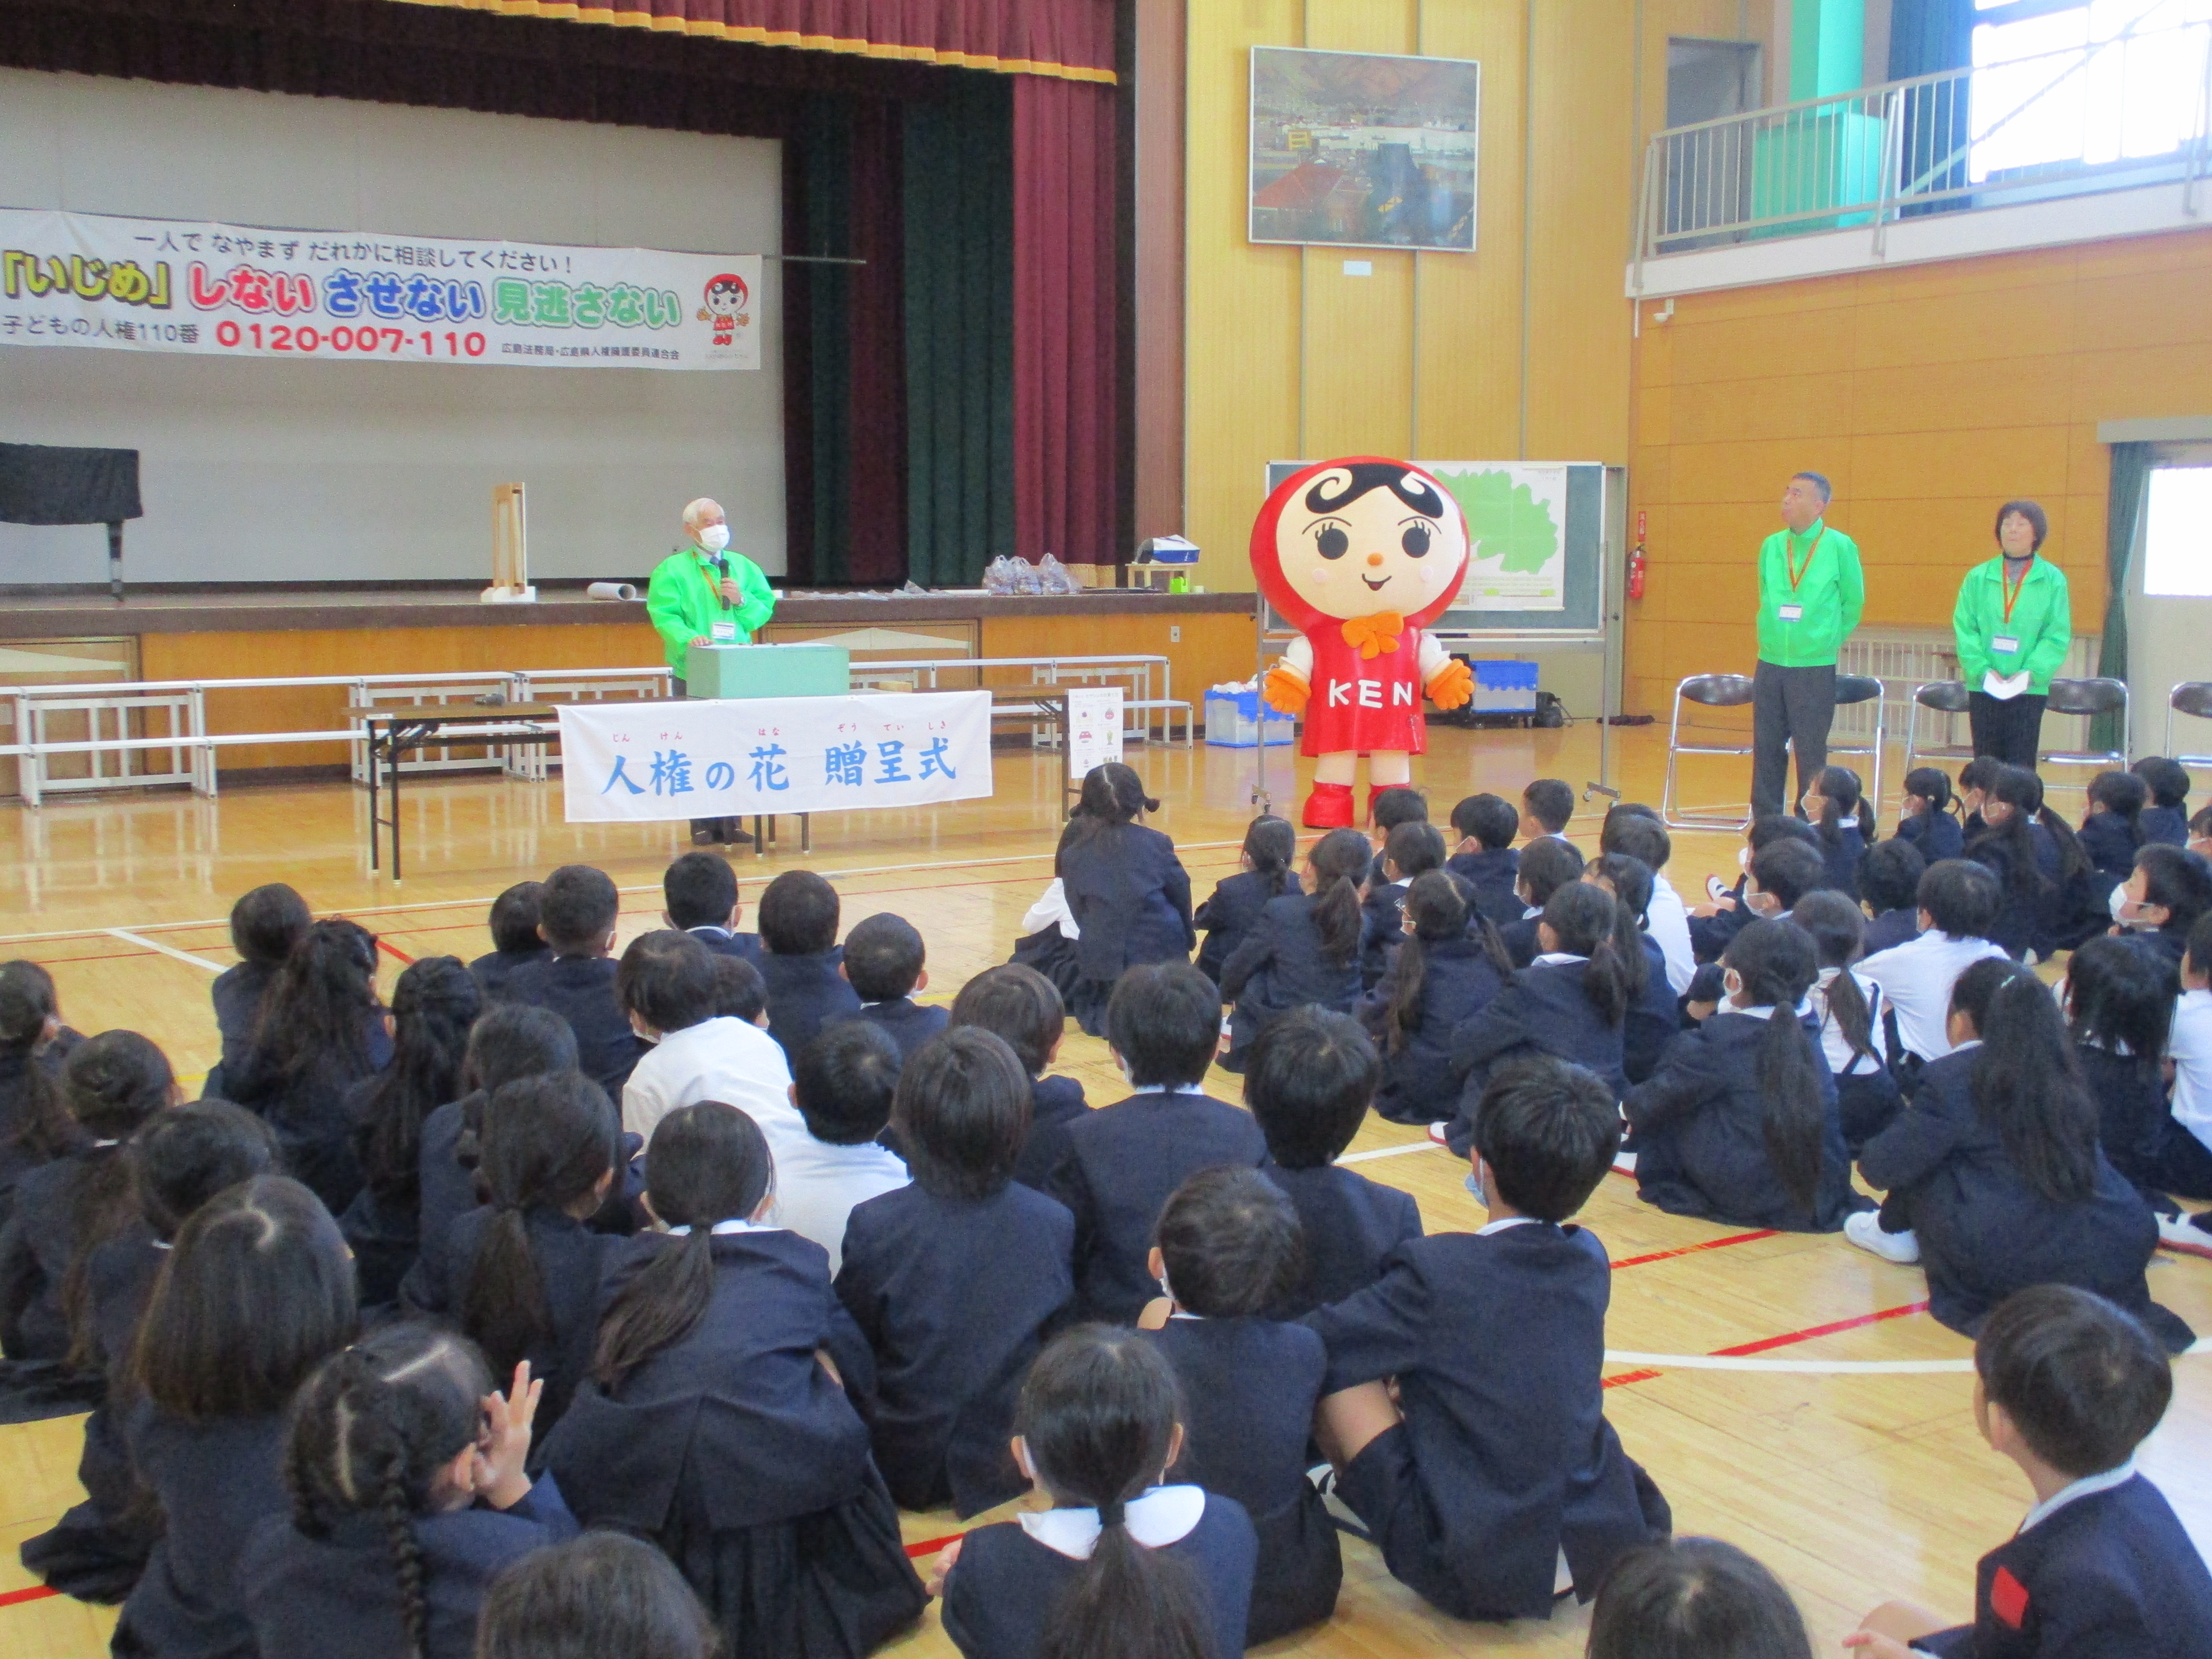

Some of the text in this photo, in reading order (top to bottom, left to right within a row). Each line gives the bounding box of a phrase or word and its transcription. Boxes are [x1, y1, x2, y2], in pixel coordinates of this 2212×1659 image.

[134, 231, 571, 273] 一人で なやまず だれかに相談してください！
[3, 250, 682, 330] 「いじめ」 しない させない 見逃さない
[3, 314, 199, 343] 子どもの人権110番
[216, 320, 486, 357] 0120-007-110
[1329, 678, 1412, 708] KEN
[601, 737, 957, 796] 人権の花 贈呈式
